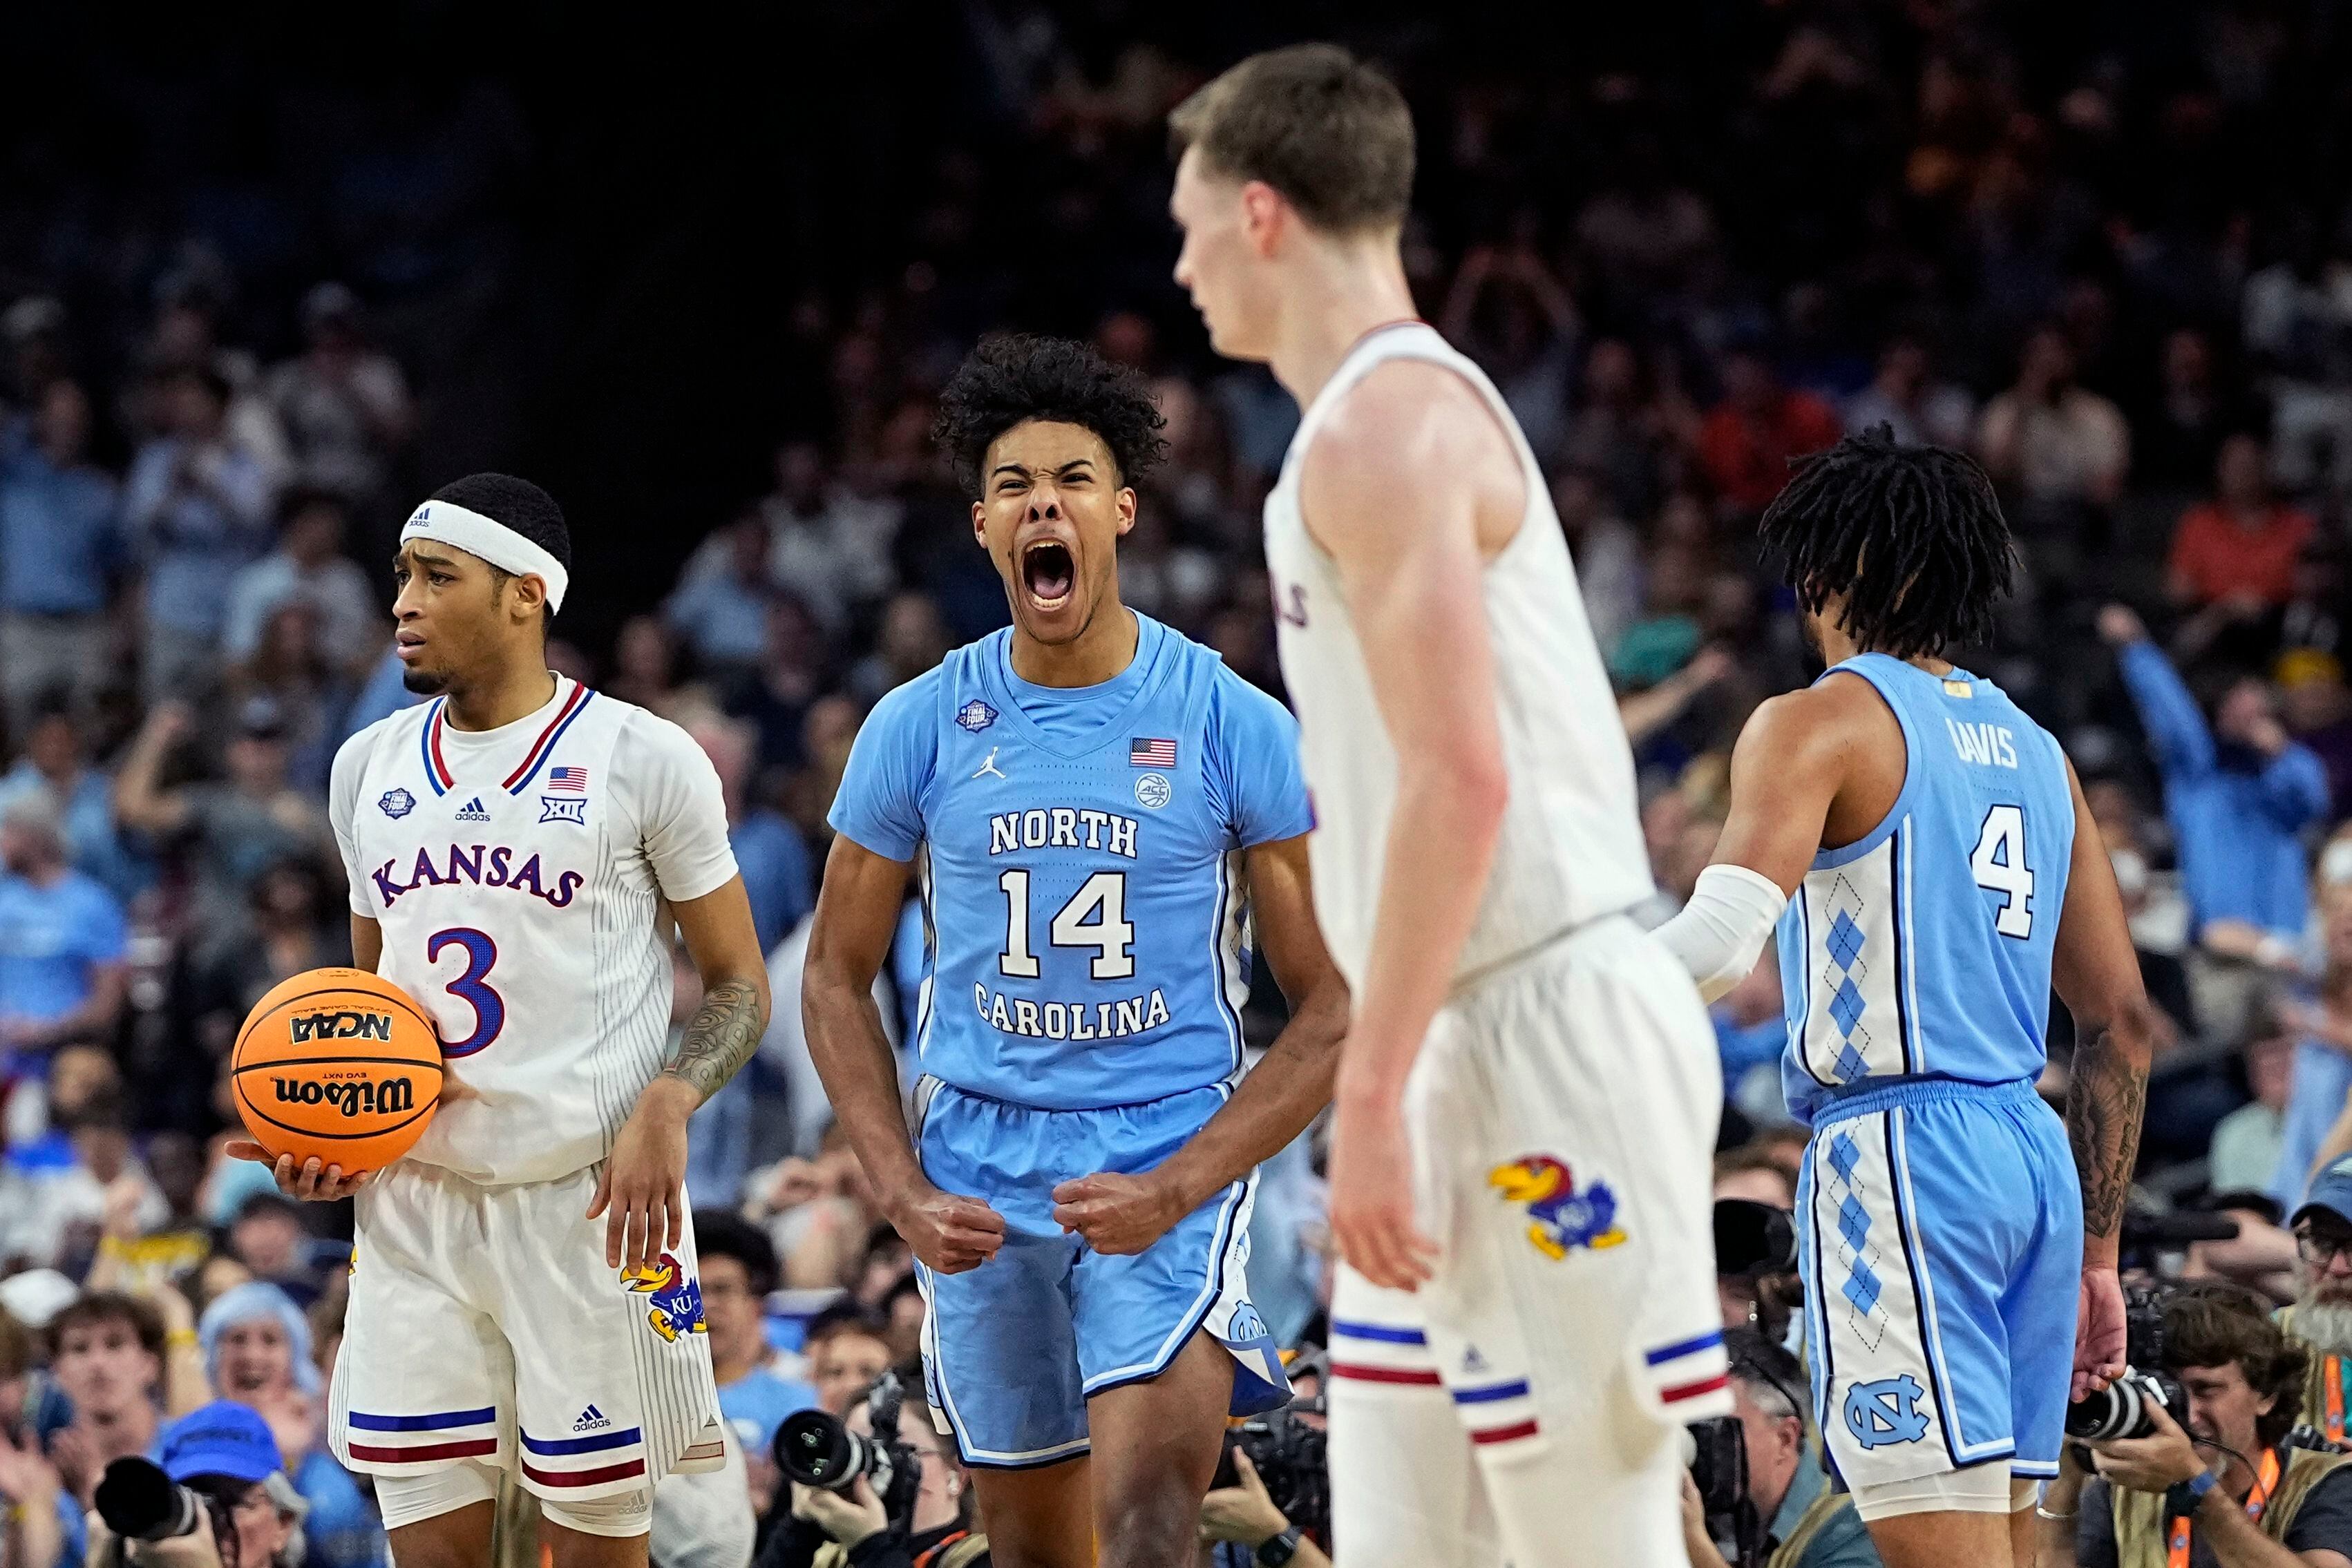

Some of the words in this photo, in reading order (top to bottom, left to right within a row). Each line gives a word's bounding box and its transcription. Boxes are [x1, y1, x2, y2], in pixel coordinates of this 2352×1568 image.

[967, 707, 986, 717] FINAL
[967, 714, 986, 725] FOUR
[390, 794, 408, 803] FINAL
[1141, 785, 1167, 796] ACC
[387, 801, 407, 811] FOUR
[455, 811, 491, 822] adidas
[989, 807, 1138, 860] NORTH
[372, 843, 584, 908] KANSAS
[1970, 803, 2034, 941] 4
[998, 868, 1135, 980] 14
[427, 927, 505, 1059] 3
[351, 1004, 392, 1014] OFFICIAL
[974, 981, 1170, 1041] CAROLINA
[290, 1011, 393, 1045] NCAA
[276, 1077, 415, 1118] Wilson
[670, 1294, 692, 1315] KU
[573, 1418, 611, 1432] adidas
